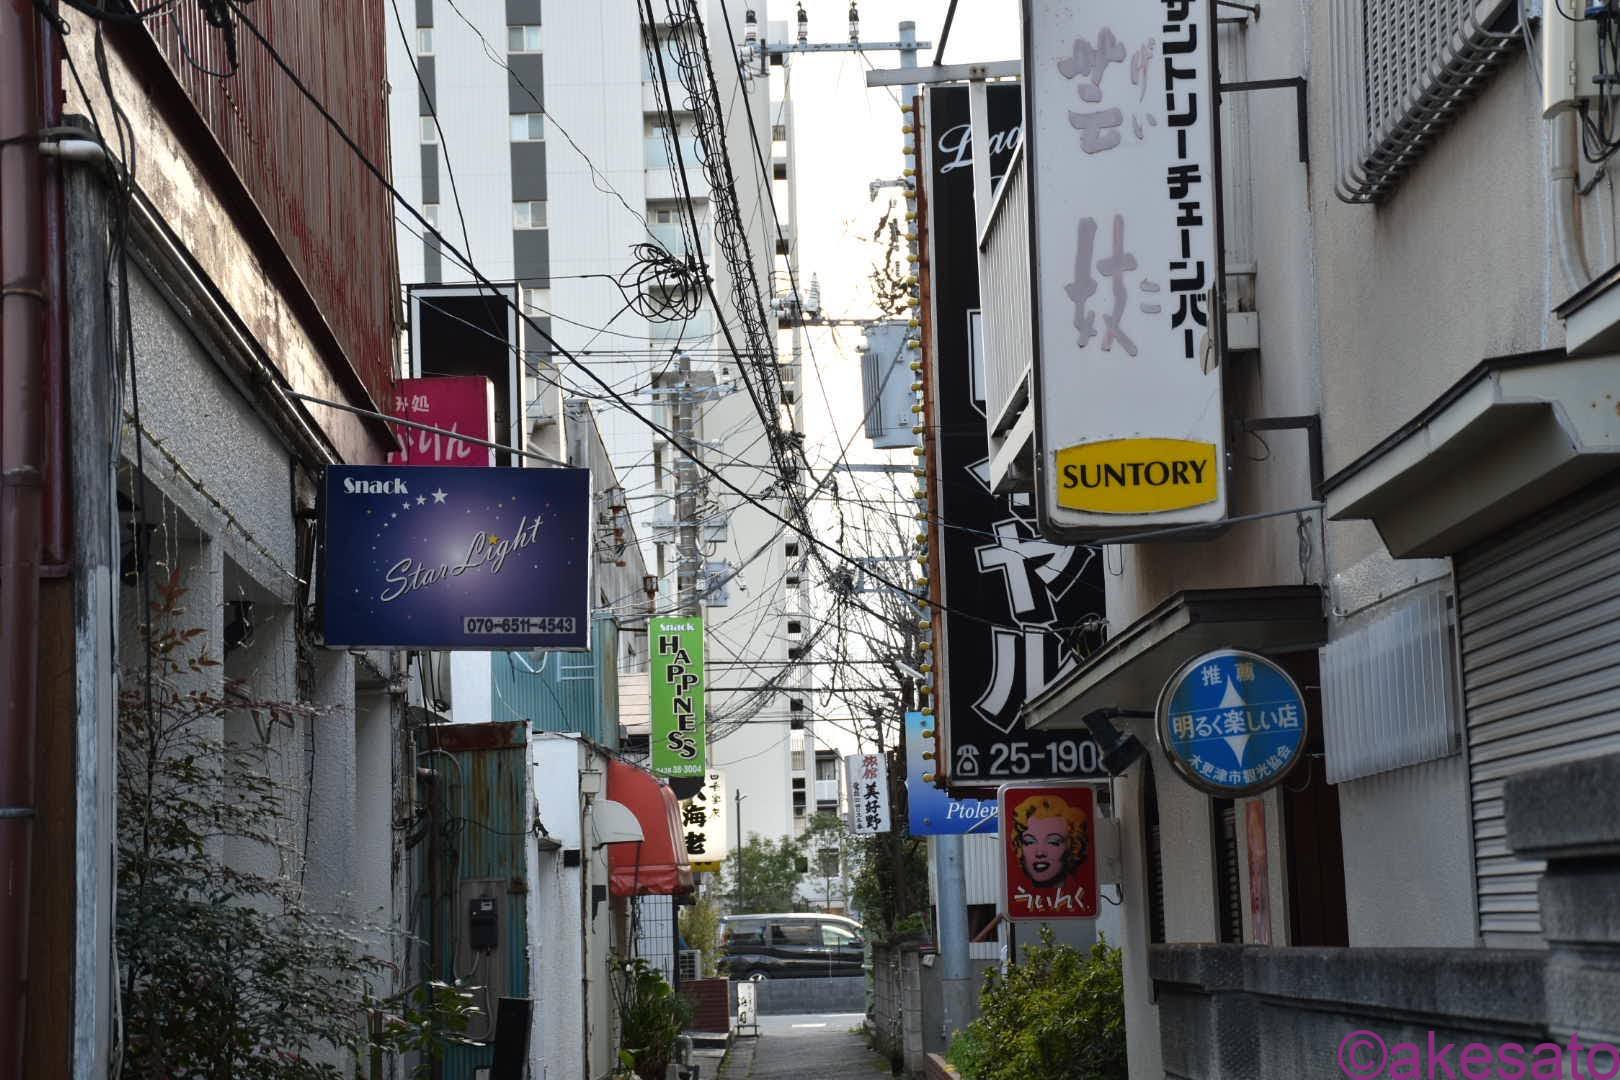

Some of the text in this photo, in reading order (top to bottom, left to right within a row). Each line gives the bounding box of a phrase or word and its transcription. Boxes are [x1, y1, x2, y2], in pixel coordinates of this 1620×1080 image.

[1160, 0, 1208, 359] サントリーチェーンバー
[343, 477, 409, 495] Snack
[1063, 459, 1208, 489] SUNTORY
[466, 617, 574, 634] 070-6511-4543
[1200, 662, 1256, 687] 推薦
[658, 634, 699, 760] HAPPINESS
[1172, 704, 1299, 740] 明るく楽しい店
[1188, 744, 1293, 785] 木更津市観光協会
[863, 781, 882, 831] 美好野
